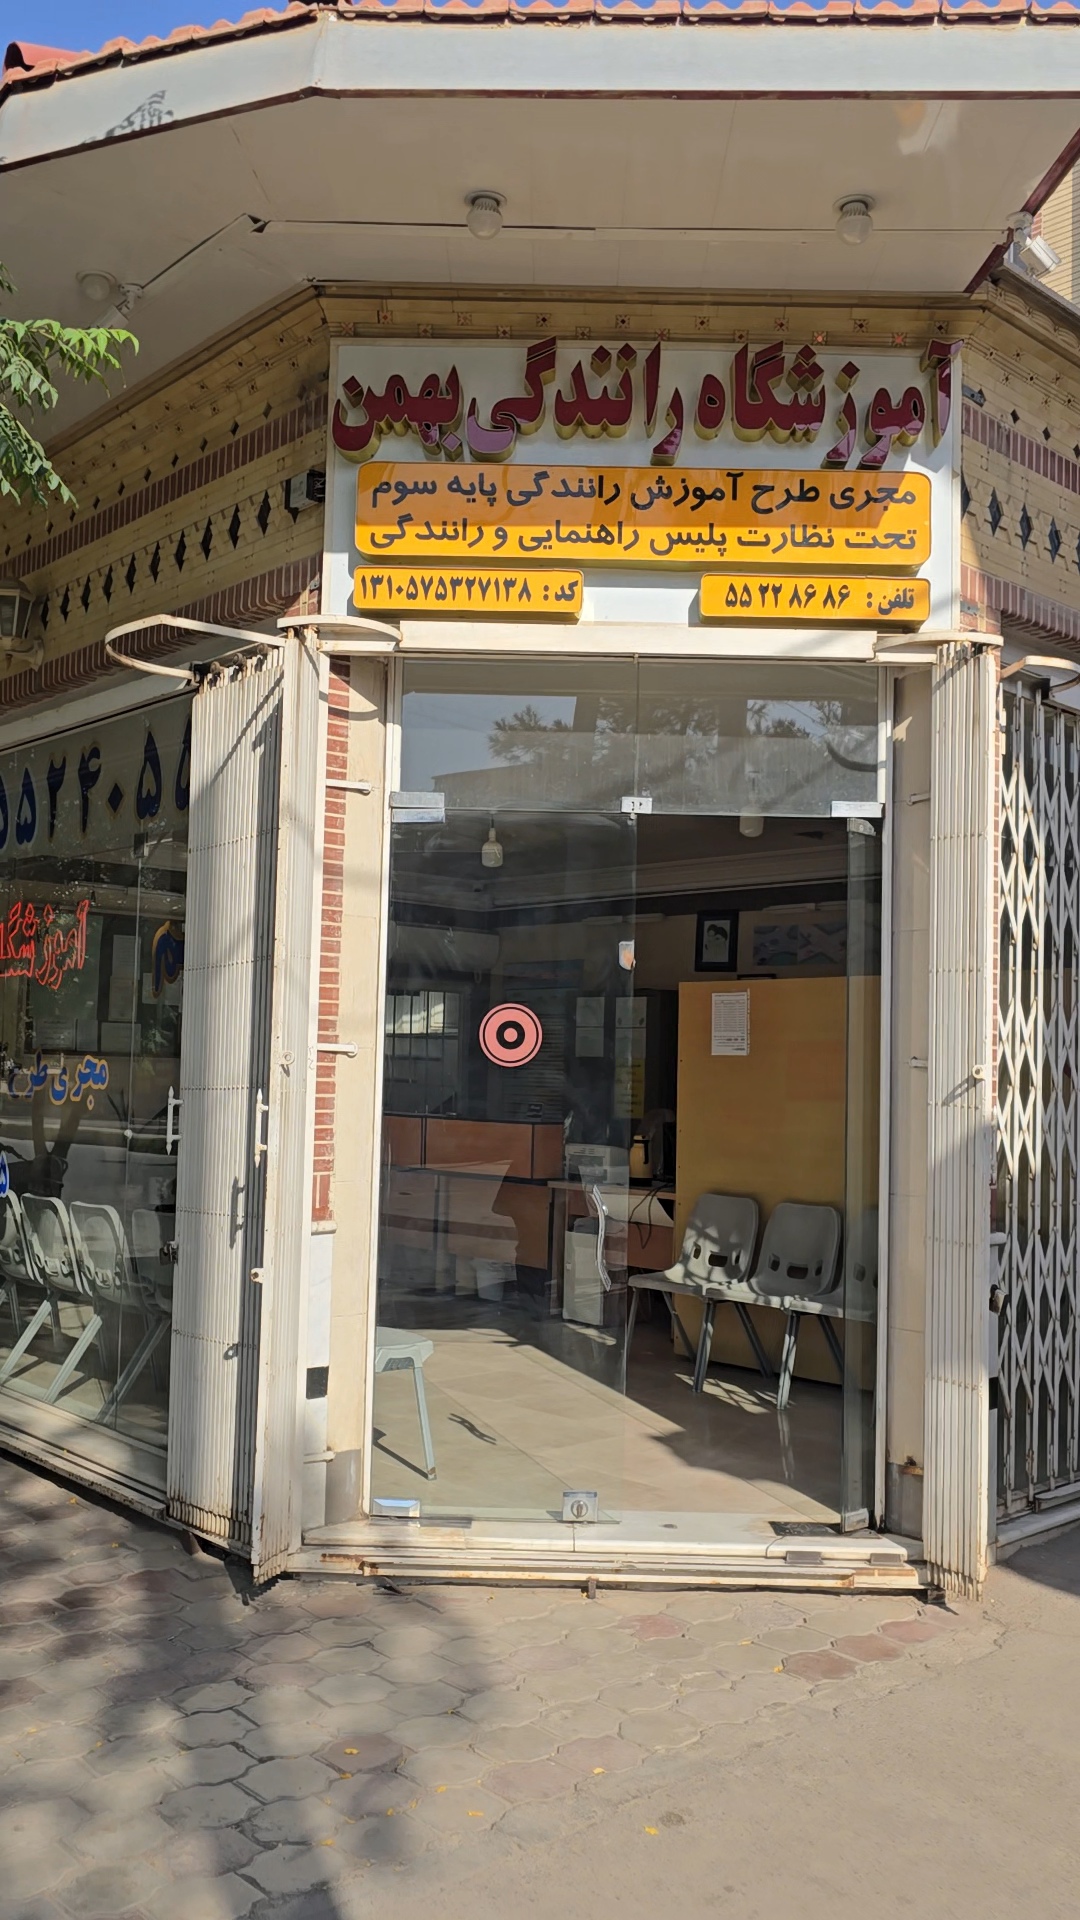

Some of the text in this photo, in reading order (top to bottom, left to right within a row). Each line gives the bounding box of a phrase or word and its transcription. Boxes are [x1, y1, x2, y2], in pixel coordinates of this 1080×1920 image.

[331, 335, 965, 469] آموزشگاه رانندگی بهمن
[371, 470, 917, 515] مجری طرح آموزش رانندگی پایه سوم
[369, 512, 917, 557] تحت نظارت پلیس راهنمایی و رانندگی
[360, 574, 532, 603] ۱۳۱۰۵۷۵۳۲۷۱۳۸
[50, 1054, 109, 1111] مجری
